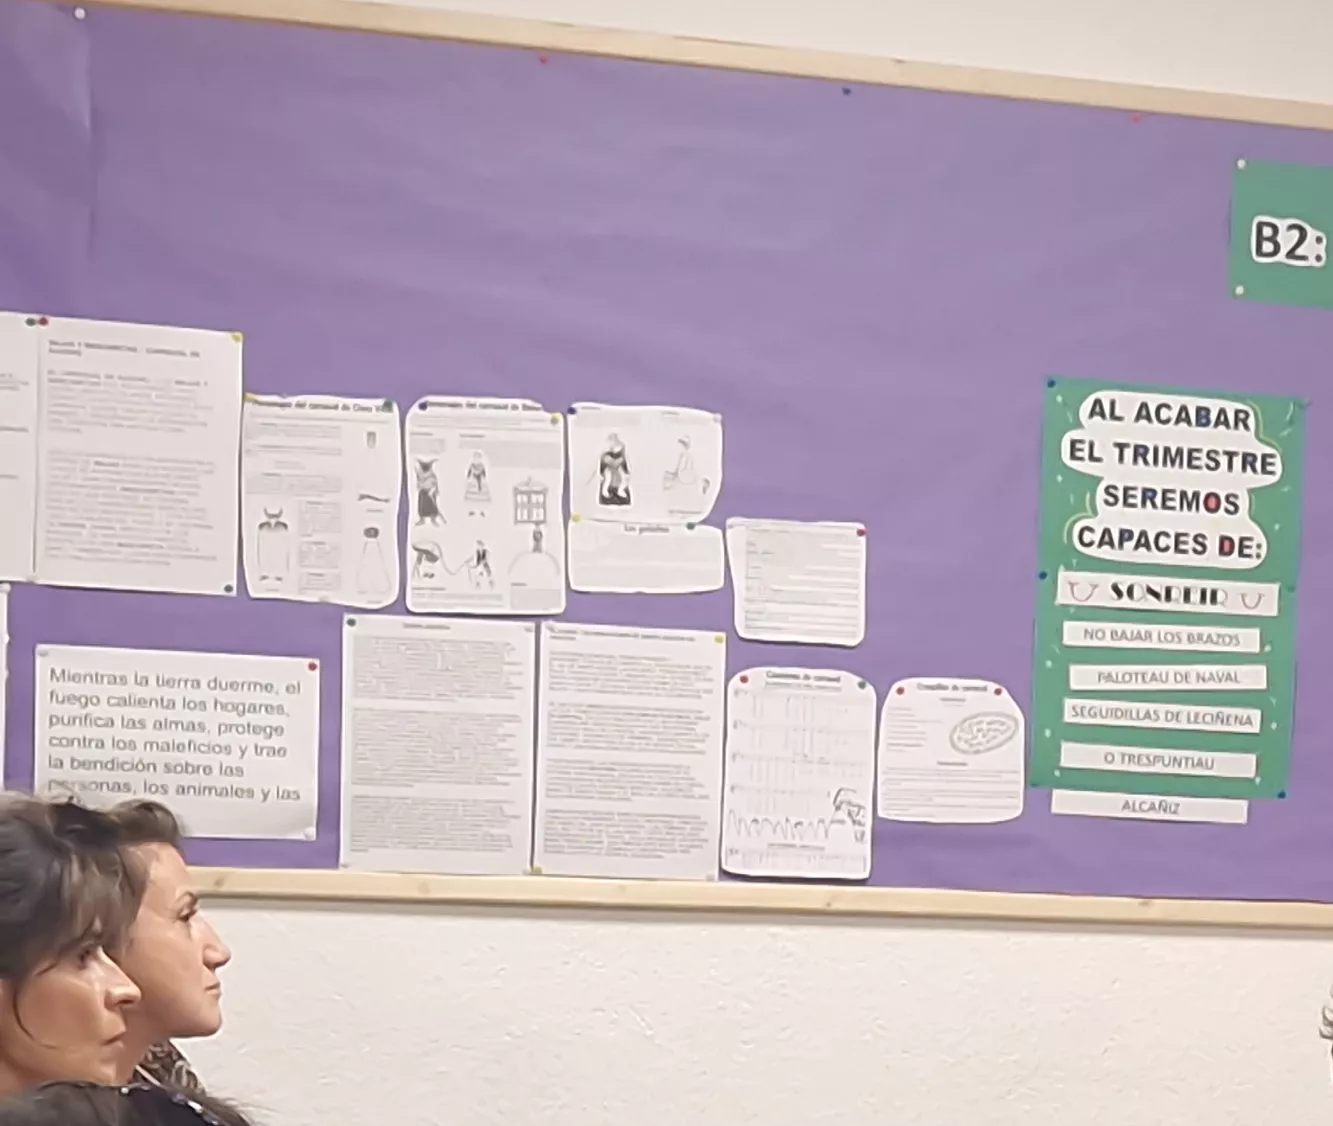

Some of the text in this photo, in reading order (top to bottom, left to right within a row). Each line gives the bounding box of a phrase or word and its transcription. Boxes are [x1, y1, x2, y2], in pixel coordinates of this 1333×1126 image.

[1254, 221, 1325, 262] B2:
[1088, 398, 1251, 431] AL ACABAR
[1070, 438, 1277, 475] EL TRIMESTRE
[1103, 485, 1240, 515] SEREMOS
[1078, 526, 1262, 559] CAPACES DE:
[1084, 628, 1240, 646] NO BAJAR LOS BRAZOS
[50, 668, 128, 686] Mientras
[134, 671, 149, 687] la
[156, 673, 201, 690] tierra
[285, 680, 300, 695] el
[1098, 671, 1240, 684] PALOTEAU DE NAVAL
[49, 690, 100, 709] fuego
[107, 693, 176, 710] calienta
[182, 697, 207, 712] los
[1071, 705, 1160, 722] SEGUIDILLAS
[1165, 709, 1182, 723] DE
[49, 713, 114, 729] purifica
[121, 715, 146, 730] las
[217, 722, 284, 740] protege
[49, 735, 287, 759] contra los maleficios y trae
[1104, 752, 1115, 764] O
[49, 755, 244, 777] la bendición sobre las
[143, 780, 169, 796] los
[176, 782, 255, 799] animales
[260, 786, 271, 803] y
[276, 785, 300, 800] las
[1121, 799, 1180, 815] ALCAÑIZ
